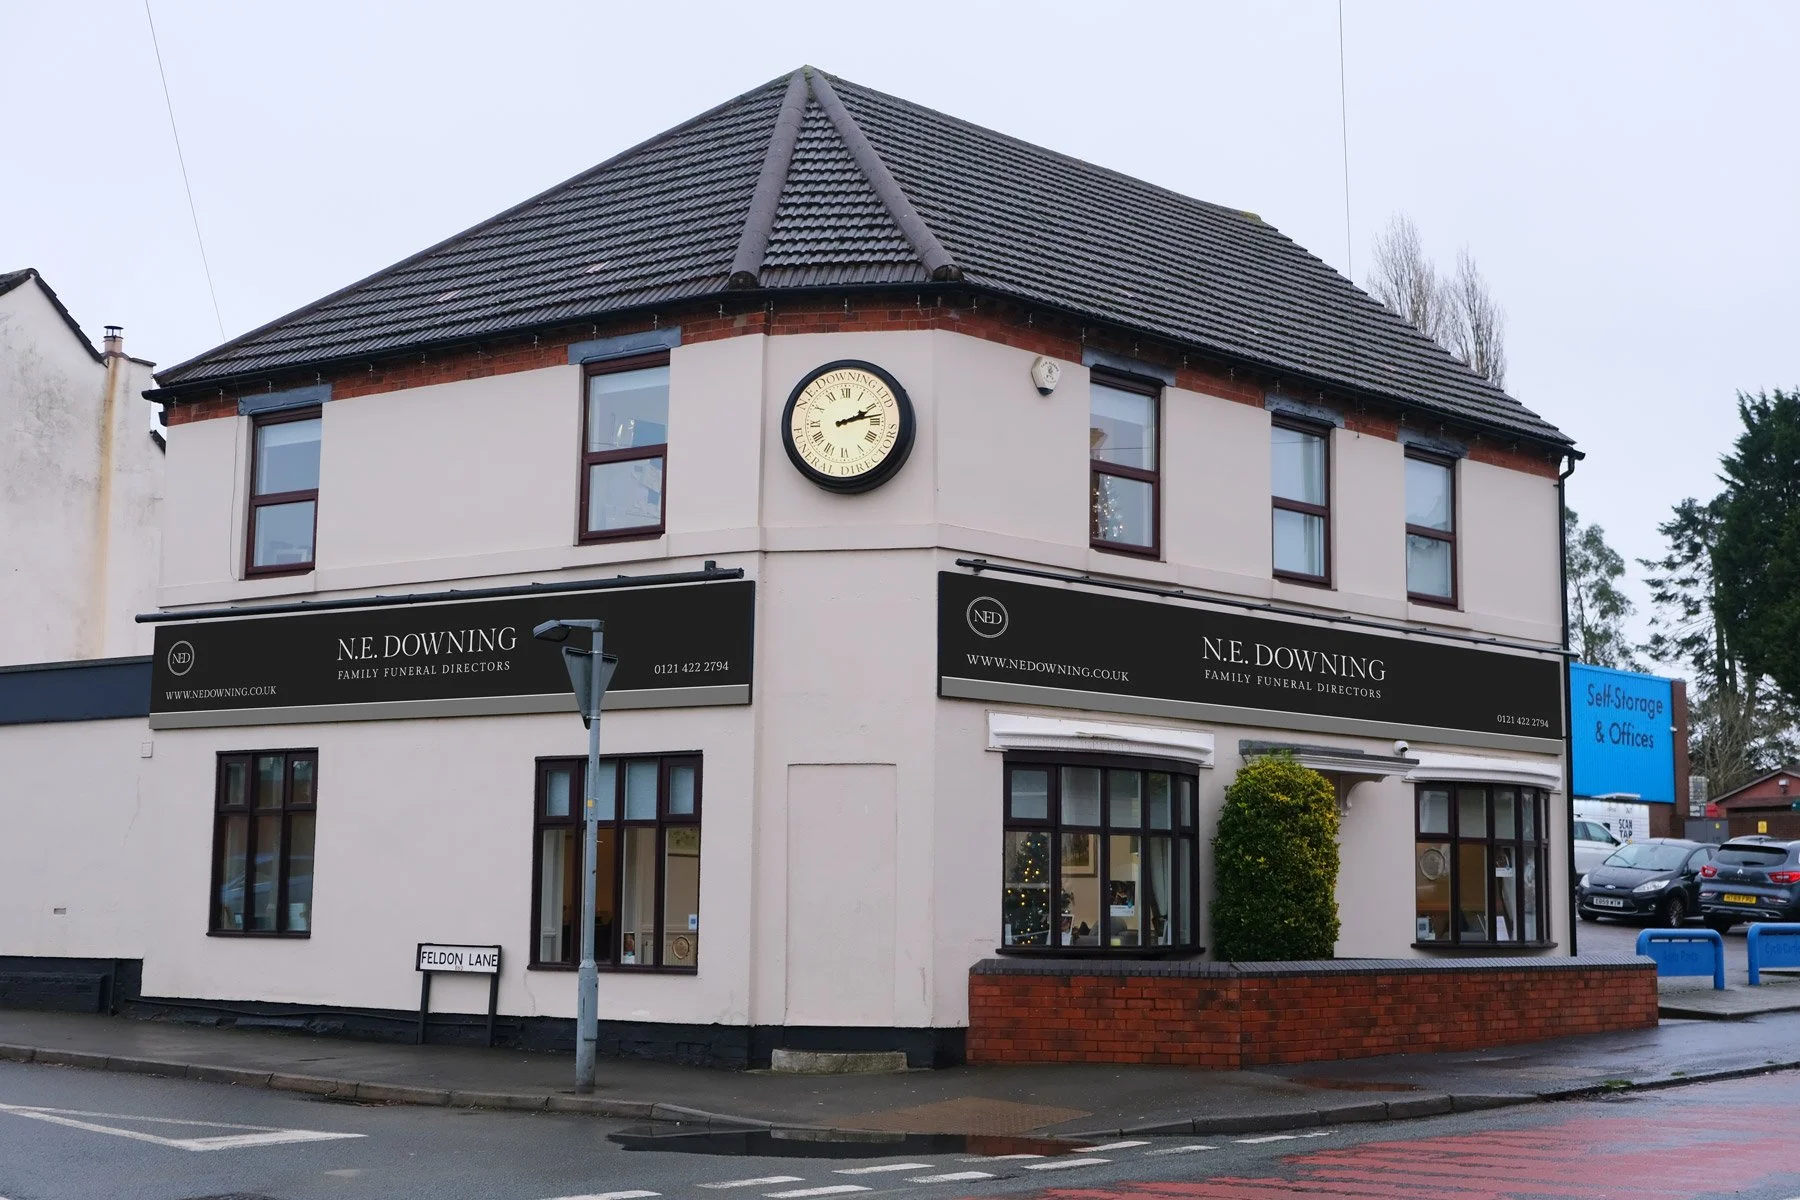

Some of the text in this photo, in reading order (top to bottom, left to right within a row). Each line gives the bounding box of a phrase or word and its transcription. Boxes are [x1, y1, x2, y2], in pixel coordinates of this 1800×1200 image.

[840, 388, 851, 399] XII
[876, 386, 893, 409] LTD
[793, 423, 897, 475] FUNERAL DIRECTORS
[971, 609, 1003, 625] NED
[336, 626, 517, 661] N.E. DOWNING
[172, 652, 191, 665] NED
[654, 660, 729, 675] 0121 422 2794
[1202, 636, 1386, 681] N.E. DOWNING
[338, 660, 510, 680] FAMILY FUNERAL DIRECTORS
[966, 654, 1129, 682] WWW.NEDOWNING.CO.UK
[166, 685, 277, 700] WWW.NEDOWNING.CO.UK
[1205, 669, 1382, 699] FAMILY FUNERAL DIRECTORS
[1587, 683, 1663, 720] Self-Storage
[1497, 714, 1549, 728] 0121 422 2794
[1595, 720, 1654, 749] & Offices
[1618, 818, 1633, 830] SCAN
[1619, 830, 1633, 840] TAP
[421, 951, 498, 967] FELDON LANE
